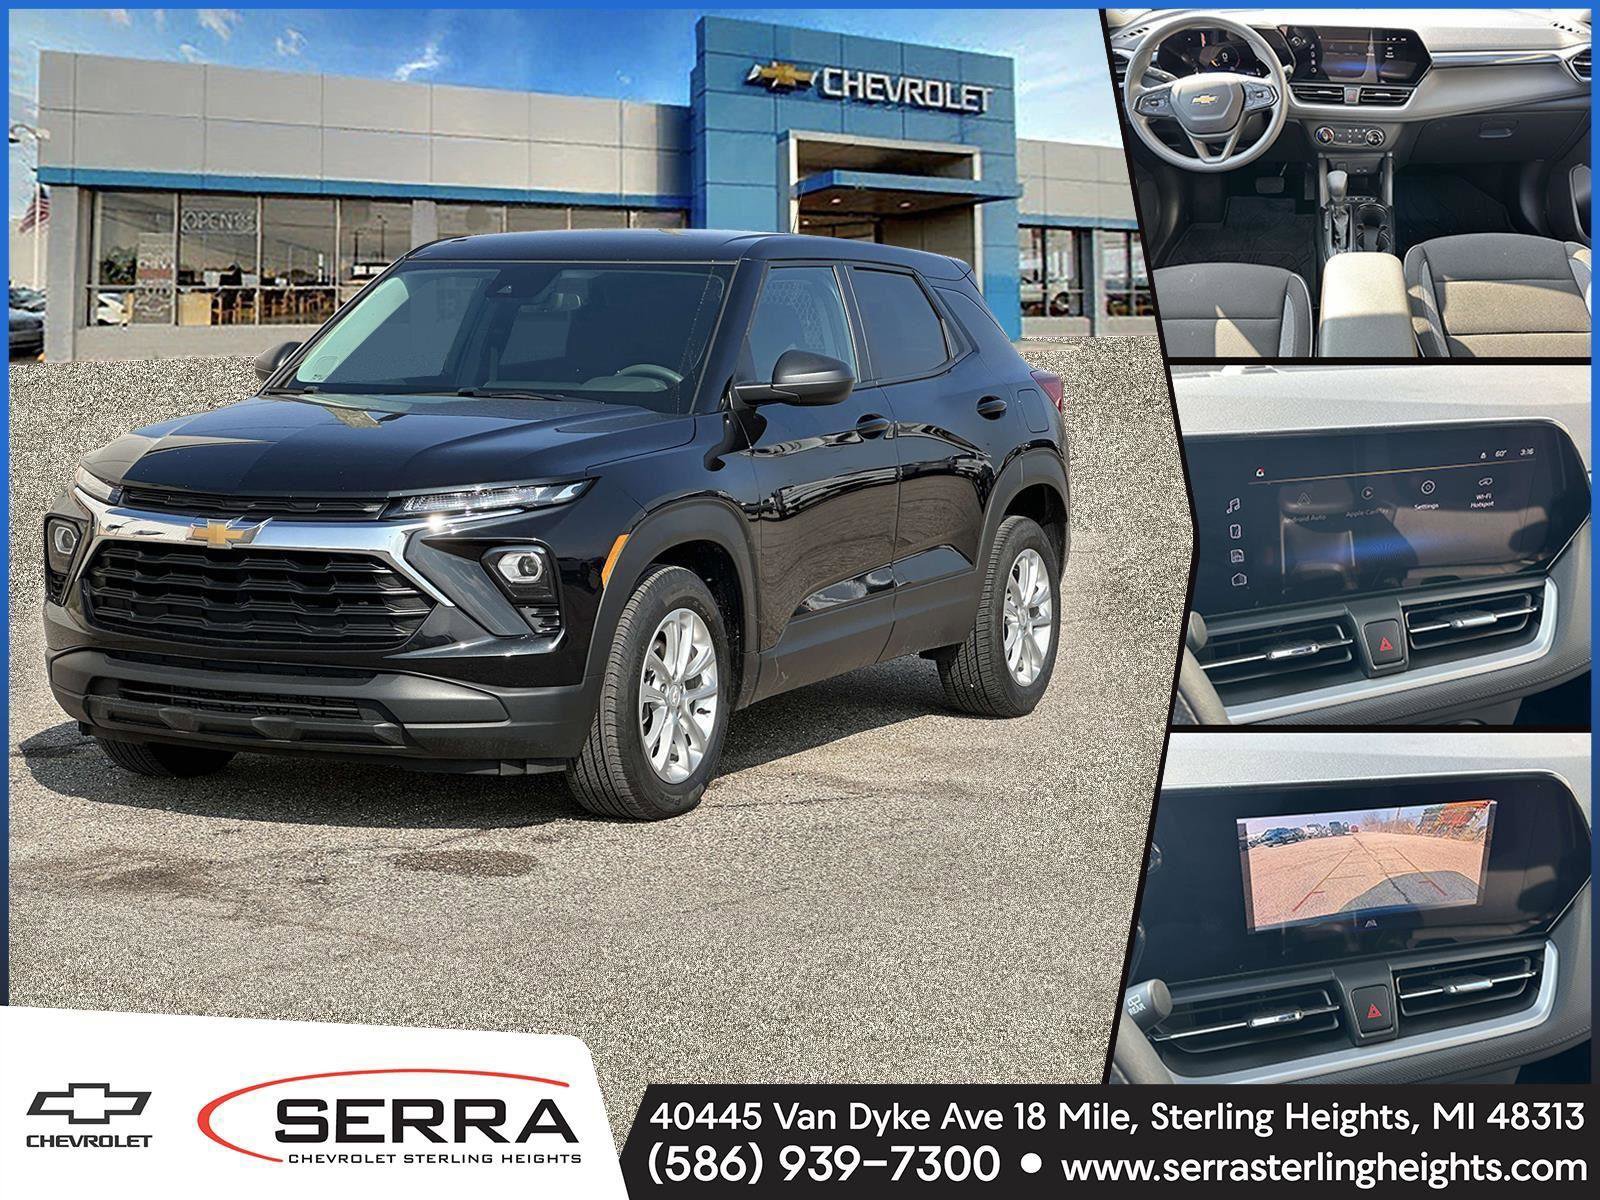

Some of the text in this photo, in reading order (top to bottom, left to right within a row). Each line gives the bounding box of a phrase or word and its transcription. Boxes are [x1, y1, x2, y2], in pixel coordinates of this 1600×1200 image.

[823, 67, 993, 111] CHEVROLET
[1414, 503, 1439, 511] Settings
[1470, 501, 1494, 509] Hotspot
[1128, 1002, 1146, 1015] REAR
